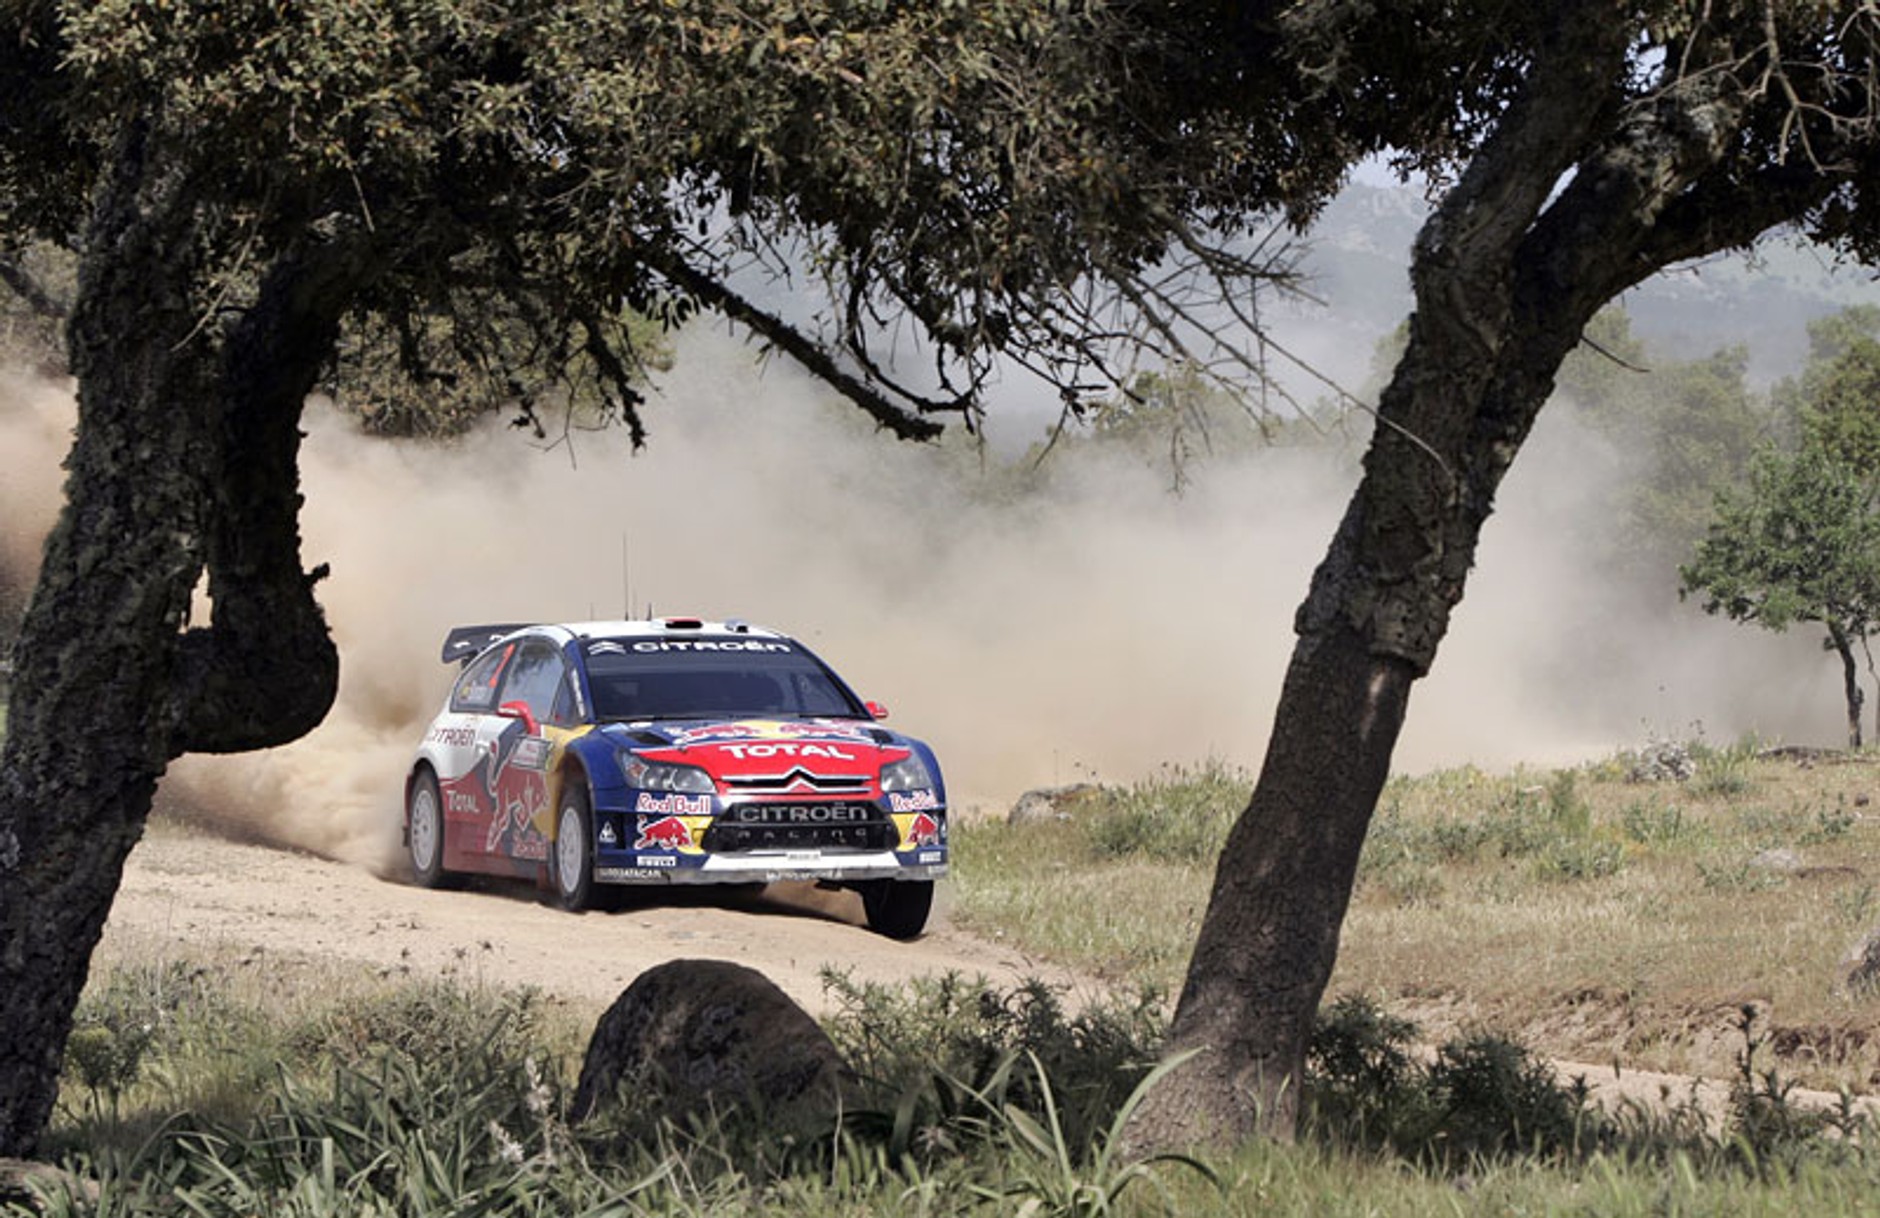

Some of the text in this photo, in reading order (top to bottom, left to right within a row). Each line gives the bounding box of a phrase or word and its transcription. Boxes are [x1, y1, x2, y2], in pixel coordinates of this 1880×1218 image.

[719, 744, 855, 760] TOTAL
[446, 789, 480, 813] TOTAL
[636, 792, 711, 814] Red Bull
